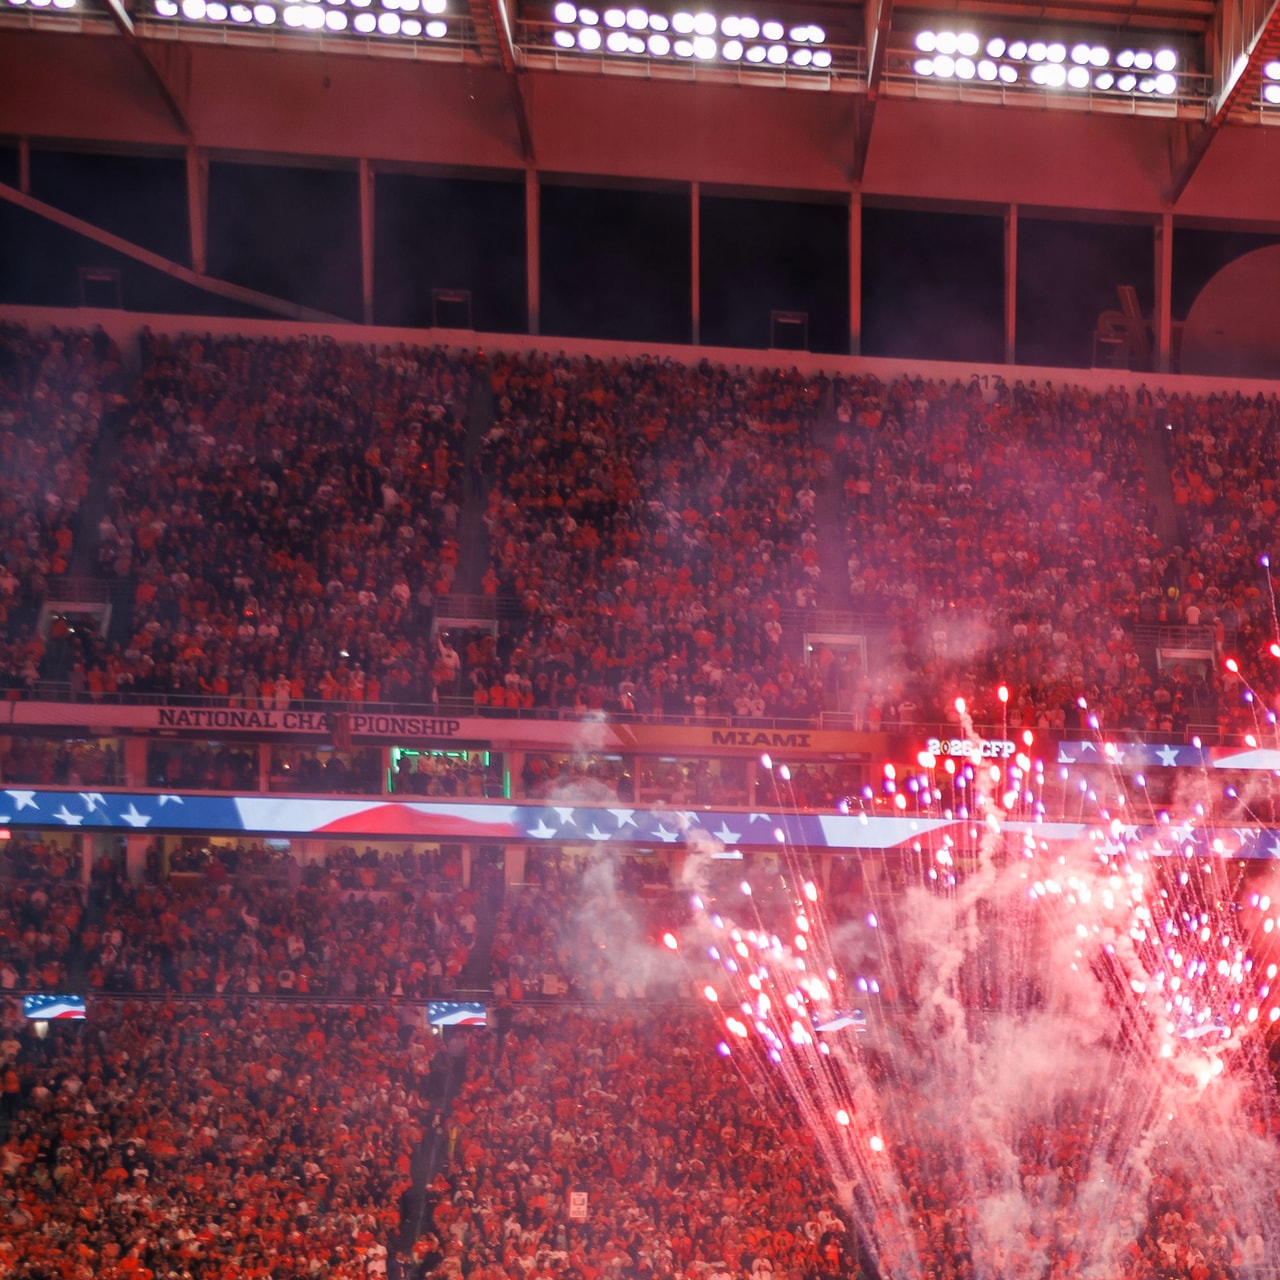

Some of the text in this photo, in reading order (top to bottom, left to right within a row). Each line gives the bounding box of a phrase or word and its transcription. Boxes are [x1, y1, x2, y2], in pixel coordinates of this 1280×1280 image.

[158, 708, 460, 737] NATIONAL CHAPIONSHIP
[711, 730, 812, 748] MIAMI
[978, 741, 1016, 758] CFP
